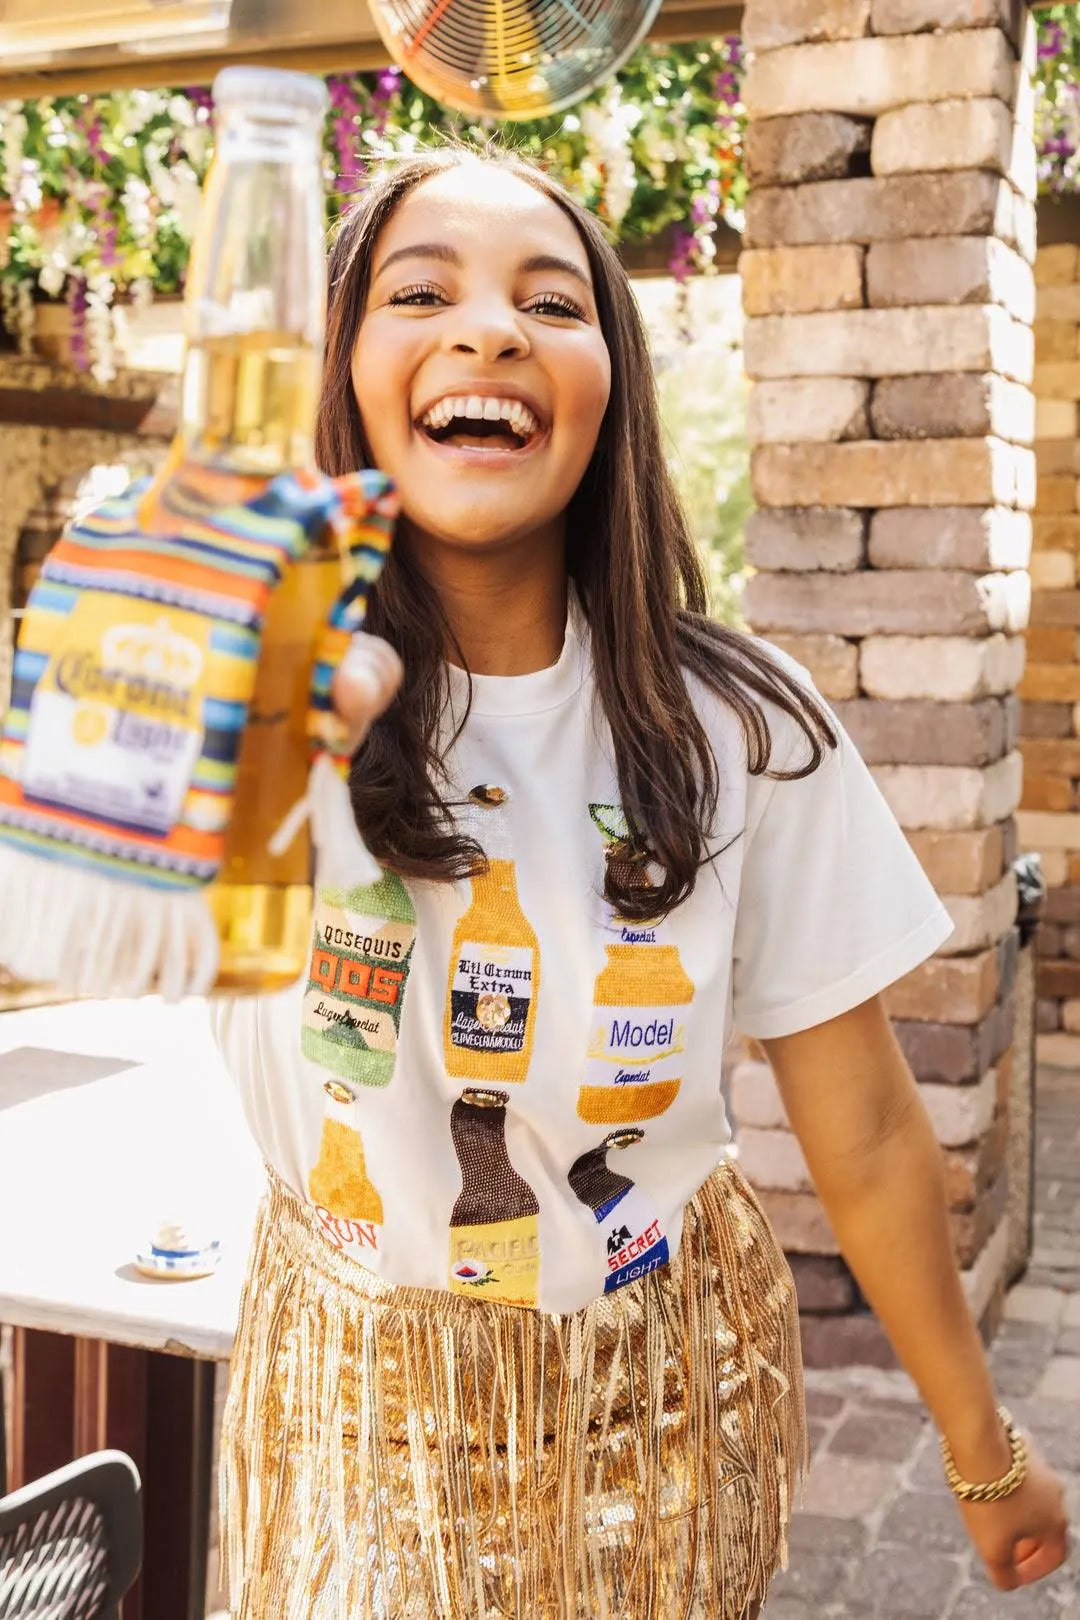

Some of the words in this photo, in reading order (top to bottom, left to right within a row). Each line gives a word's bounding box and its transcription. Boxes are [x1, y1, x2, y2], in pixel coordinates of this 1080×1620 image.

[469, 975, 515, 995] Extra
[610, 1018, 674, 1047] Model
[607, 1218, 662, 1272] SECRET
[615, 1256, 662, 1285] LIGHT
